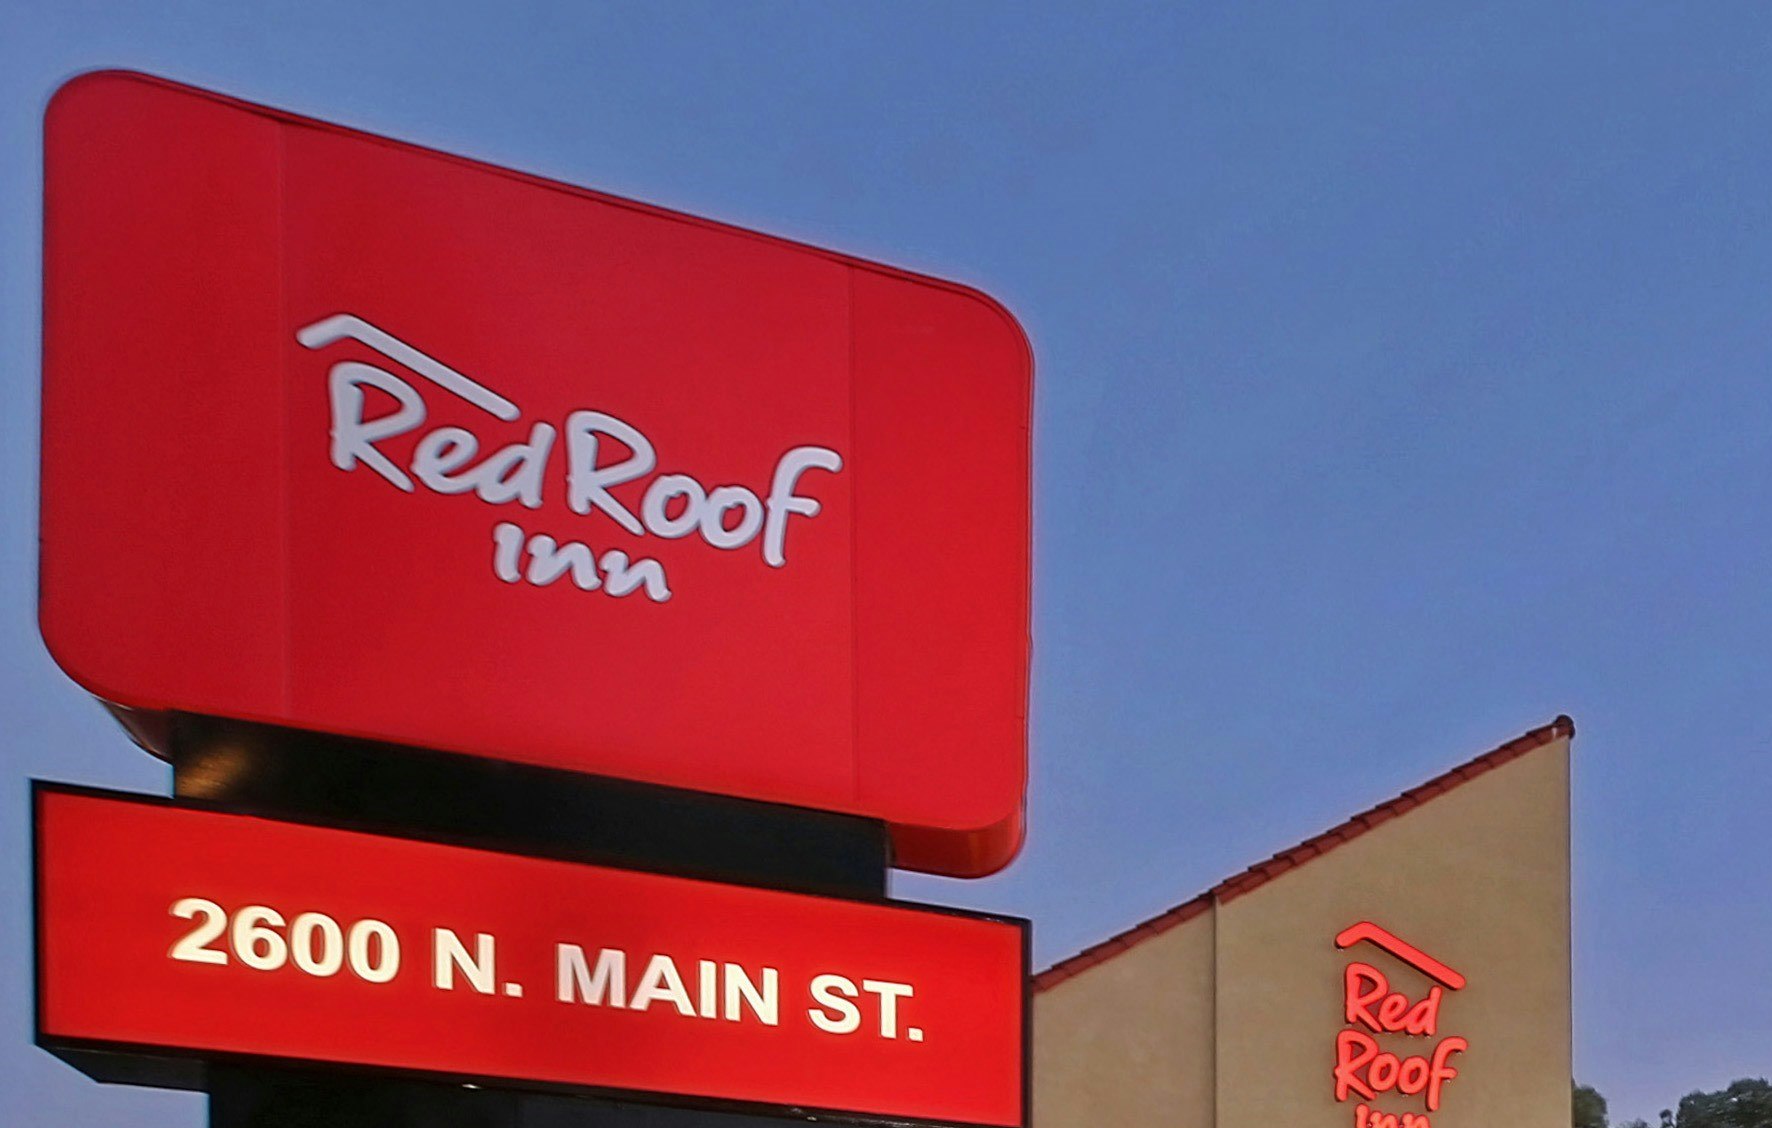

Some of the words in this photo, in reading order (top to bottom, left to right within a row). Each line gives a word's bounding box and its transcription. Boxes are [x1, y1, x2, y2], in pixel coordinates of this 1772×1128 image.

[171, 897, 400, 983] 2600
[435, 929, 524, 997] N.
[558, 943, 779, 1026] MAIN
[808, 974, 925, 1042] ST.
[1344, 961, 1444, 1036] Red
[1333, 1028, 1470, 1112] Roof
